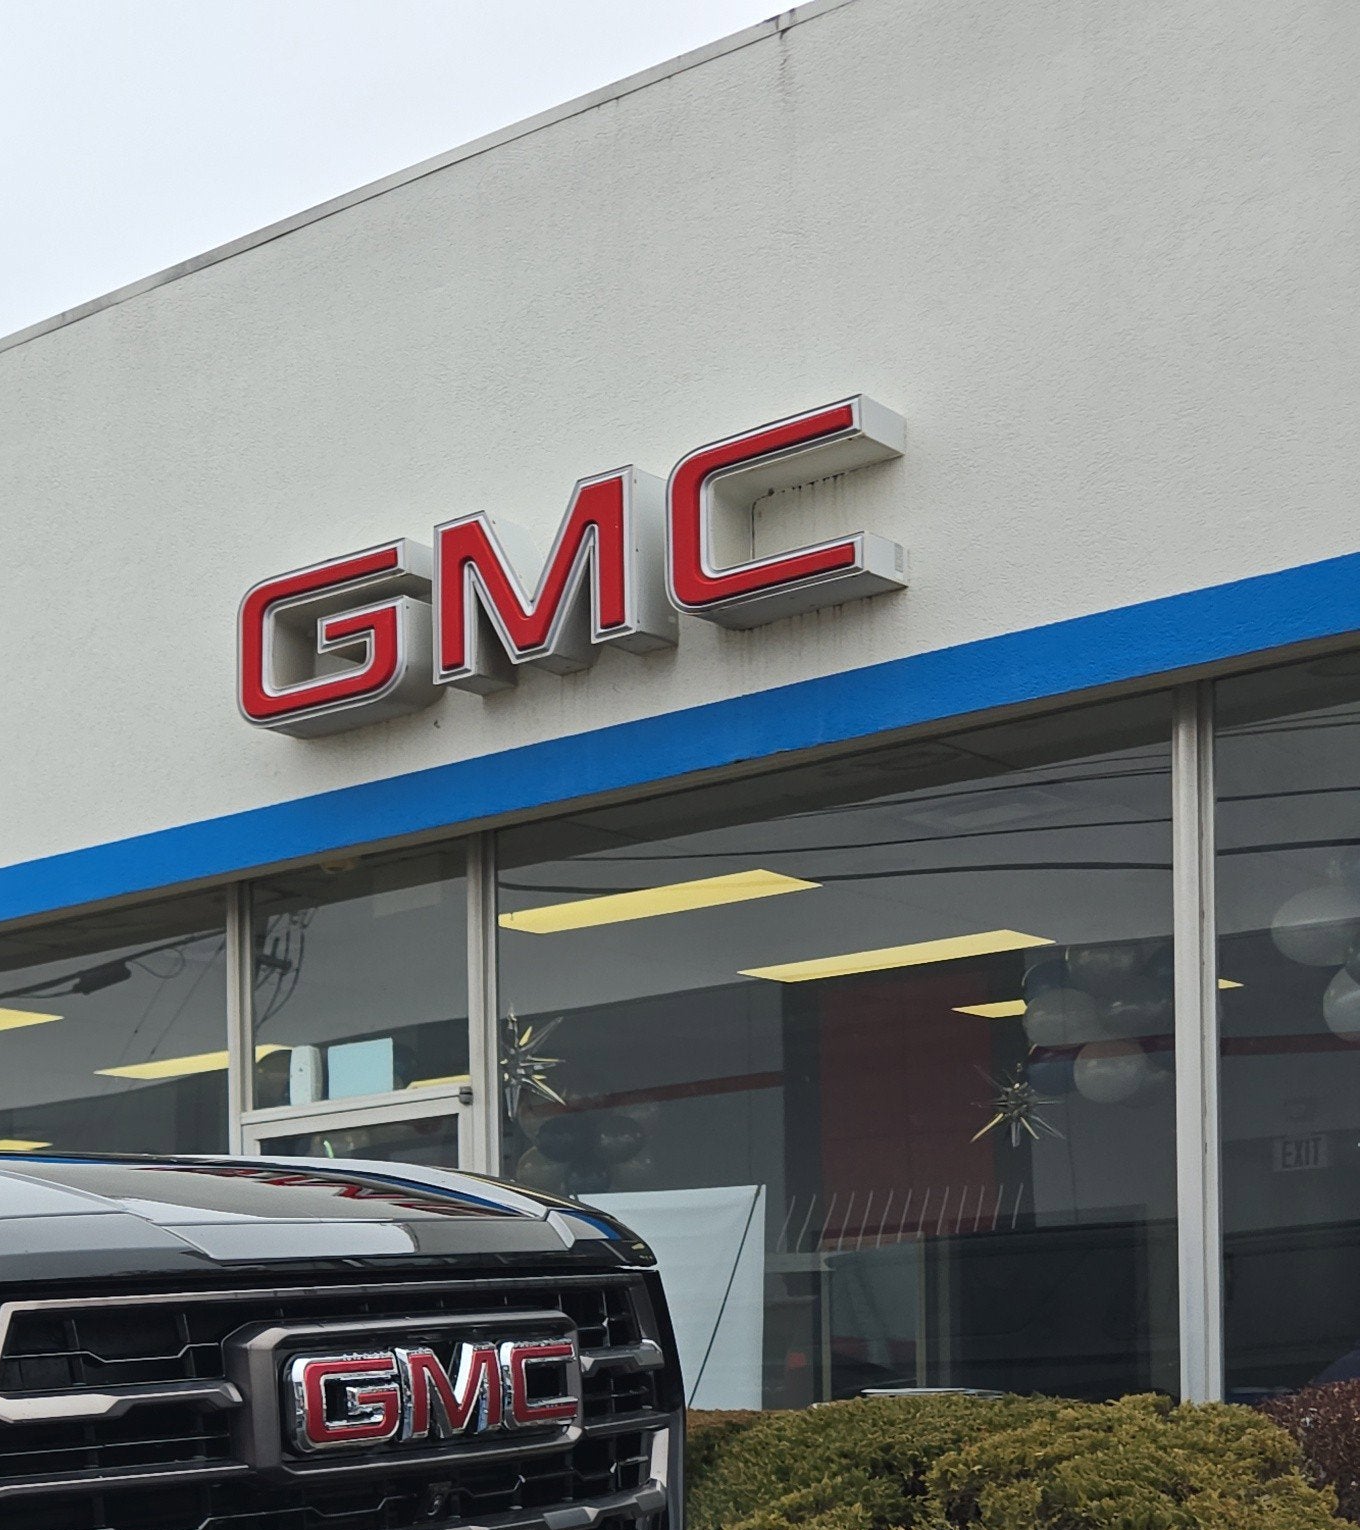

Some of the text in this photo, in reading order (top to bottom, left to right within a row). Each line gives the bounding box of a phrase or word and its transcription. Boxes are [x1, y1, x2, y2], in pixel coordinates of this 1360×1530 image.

[237, 395, 907, 734] GMC
[1281, 1137, 1322, 1169] EXIT
[292, 1338, 579, 1452] GMC
